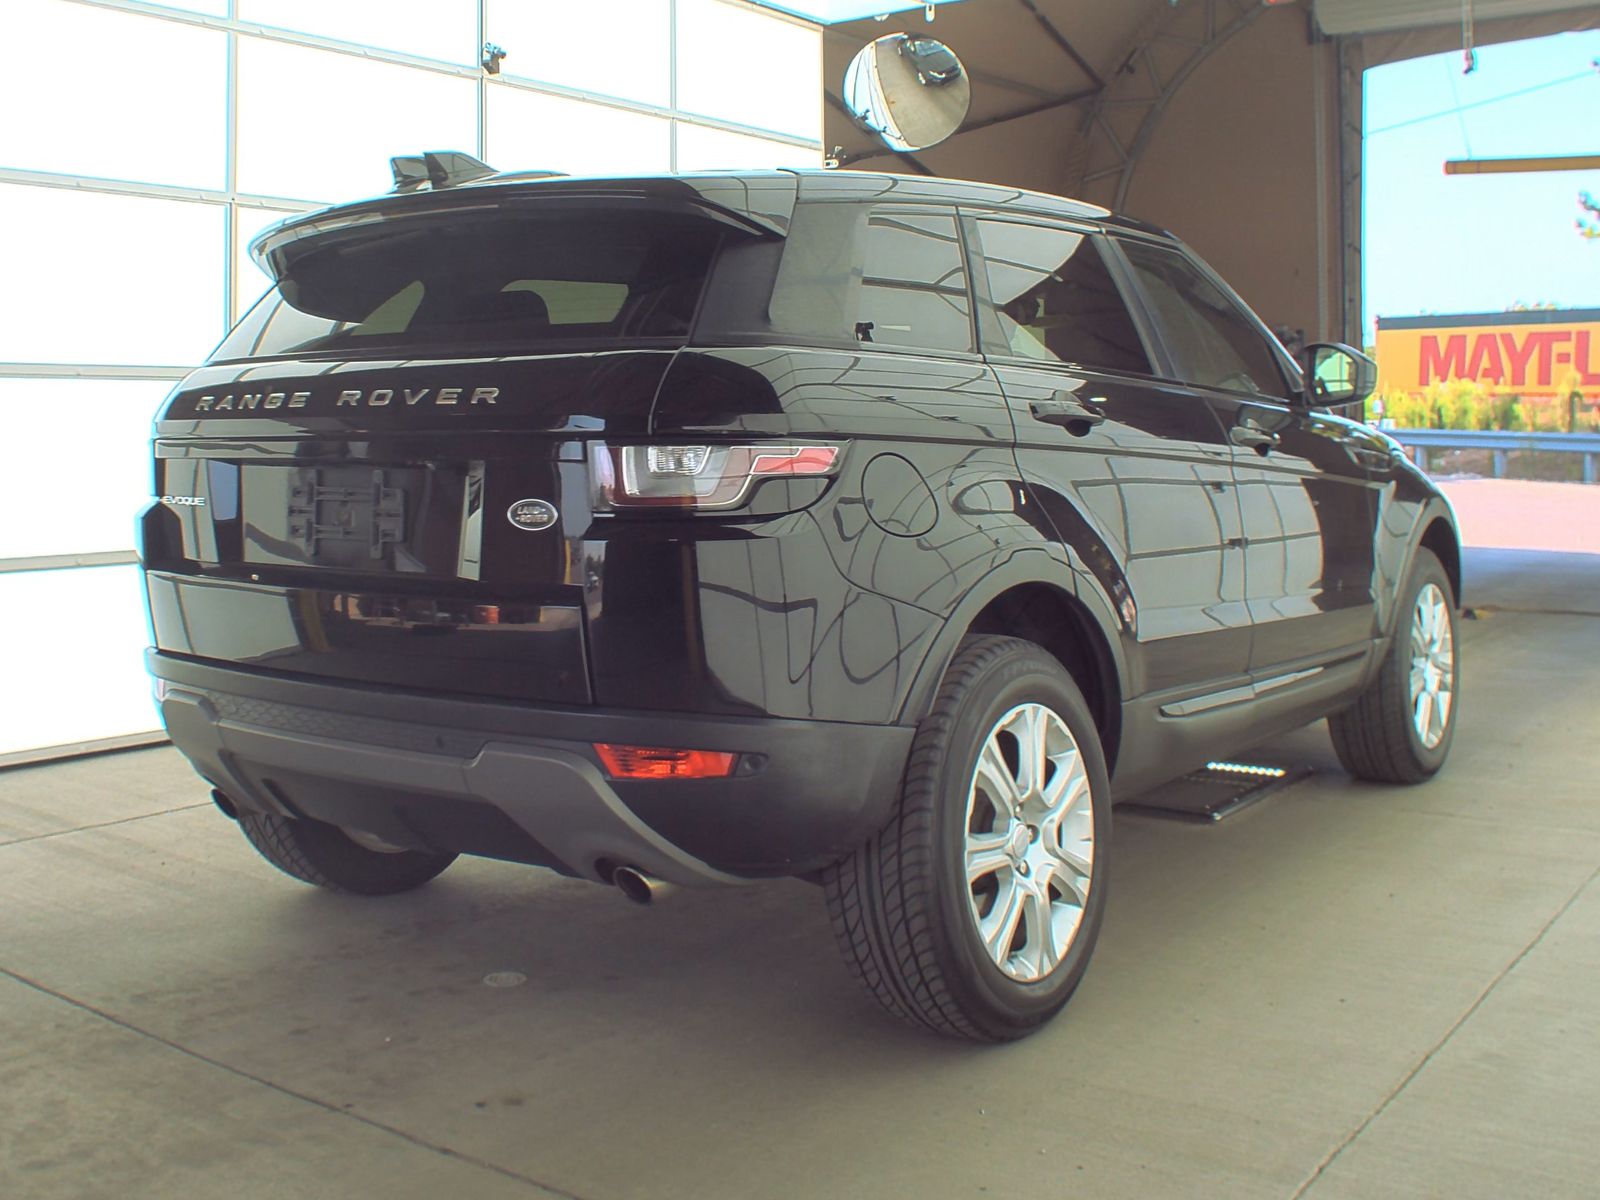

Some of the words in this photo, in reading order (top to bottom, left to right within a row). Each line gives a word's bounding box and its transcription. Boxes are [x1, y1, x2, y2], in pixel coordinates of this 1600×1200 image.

[194, 391, 312, 411] RANGE
[336, 387, 500, 406] ROVER
[160, 495, 205, 506] EVOQUE
